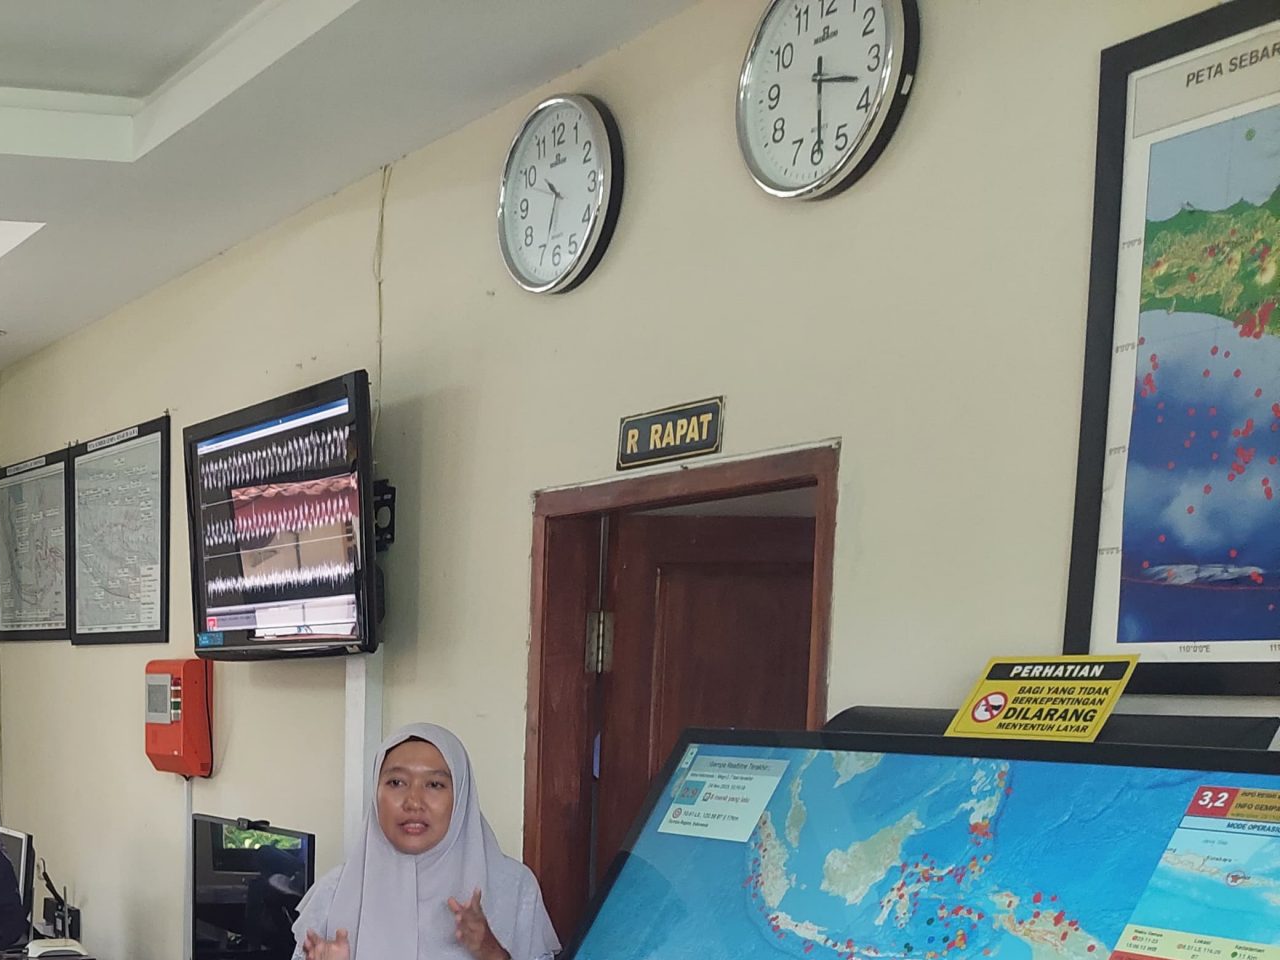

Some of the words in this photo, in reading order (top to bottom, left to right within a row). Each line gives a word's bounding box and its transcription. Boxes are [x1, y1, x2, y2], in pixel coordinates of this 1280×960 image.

[795, 5, 810, 36] 11
[862, 6, 876, 38] 2
[774, 42, 794, 72] 10
[867, 43, 881, 72] 3
[1186, 62, 1224, 88] PETA
[1228, 42, 1280, 73] SEBAR
[767, 83, 781, 110] 9
[856, 85, 871, 113] 4
[551, 122, 566, 148] 12
[573, 121, 579, 144] 1
[772, 117, 785, 143] 8
[834, 123, 848, 151] 5
[536, 135, 546, 160] 11
[582, 140, 592, 164] 2
[792, 138, 804, 166] 7
[810, 140, 824, 166] 6
[523, 165, 537, 189] 10
[587, 170, 597, 192] 3
[520, 198, 529, 220] 9
[581, 203, 591, 224] 4
[524, 226, 533, 246] 8
[568, 234, 578, 255] 5
[538, 244, 547, 267] 7
[551, 245, 561, 266] 6
[626, 428, 639, 454] R
[649, 412, 713, 450] RAPAT
[1009, 664, 1104, 678] PERHATIAN
[1011, 697, 1105, 706] BERKEPENTINGAN
[1018, 686, 1045, 695] BAGI
[1046, 686, 1076, 695] YANG
[1077, 686, 1112, 696] TIDAK
[1002, 707, 1098, 722] DILARANG
[996, 722, 1056, 732] MENYENTUH
[1056, 724, 1089, 733] LAYAR
[1198, 791, 1229, 808] 3,2
[1227, 822, 1247, 830] MODE
